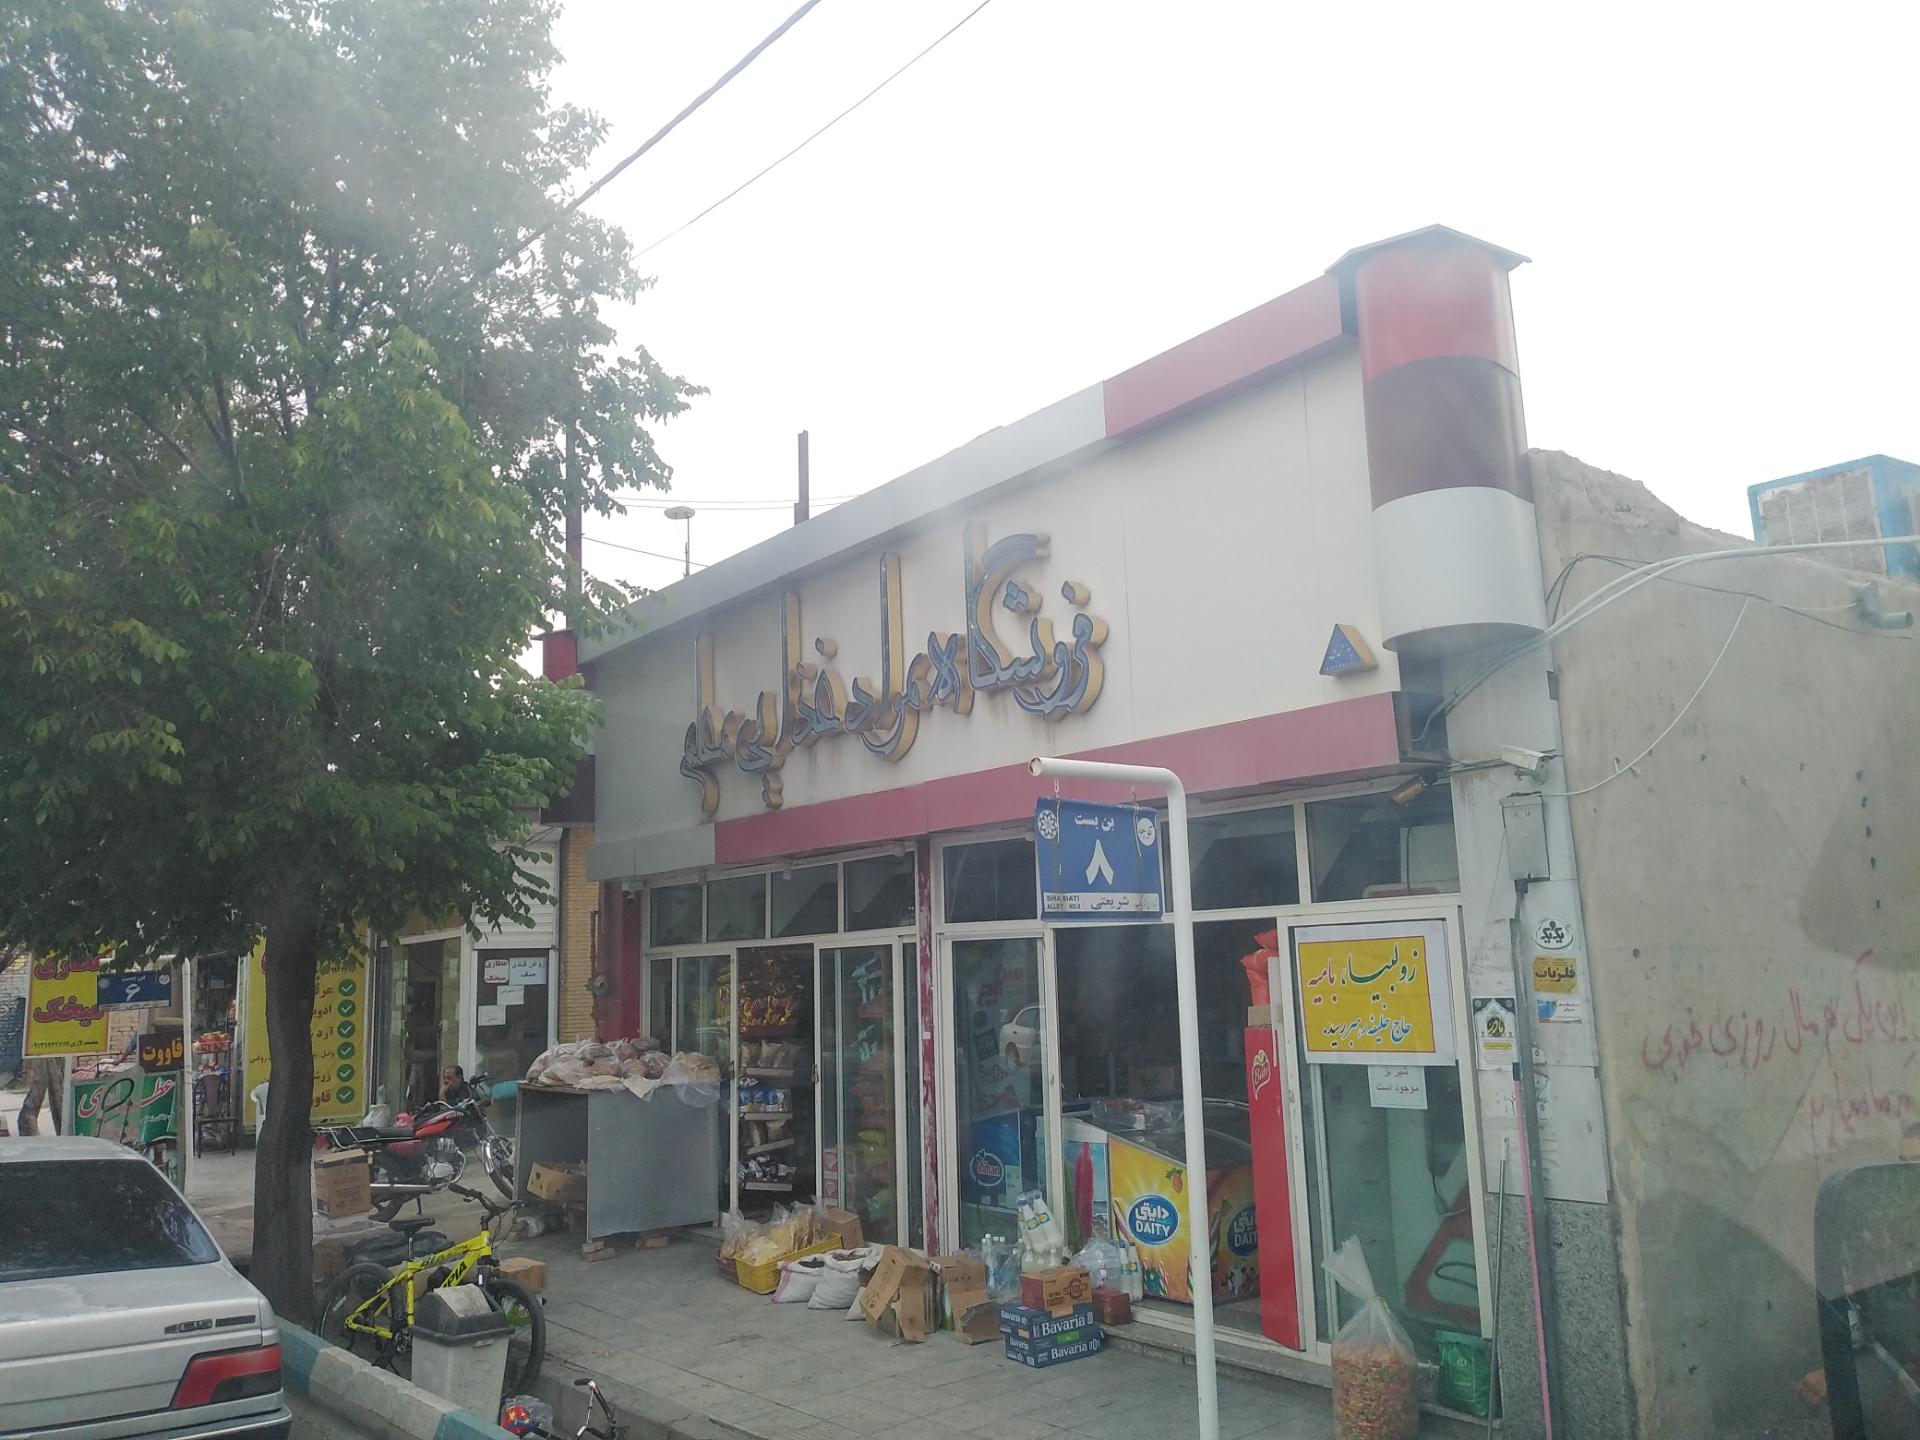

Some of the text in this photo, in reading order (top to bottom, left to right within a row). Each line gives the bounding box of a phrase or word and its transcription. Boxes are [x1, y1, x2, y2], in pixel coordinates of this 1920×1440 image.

[928, 521, 1108, 720] فروشگاه
[845, 552, 932, 763] مواد
[1074, 814, 1115, 831] بن بست
[1086, 838, 1115, 886] ۸
[1090, 895, 1130, 910] شریعتی
[1308, 959, 1336, 1004] بامیه
[1535, 964, 1576, 982] فلزیاب
[142, 1036, 183, 1067] قاووت
[1135, 1220, 1171, 1237] DAITY
[1041, 1314, 1086, 1337] Bavaria
[1050, 1341, 1088, 1360] Bavaria
